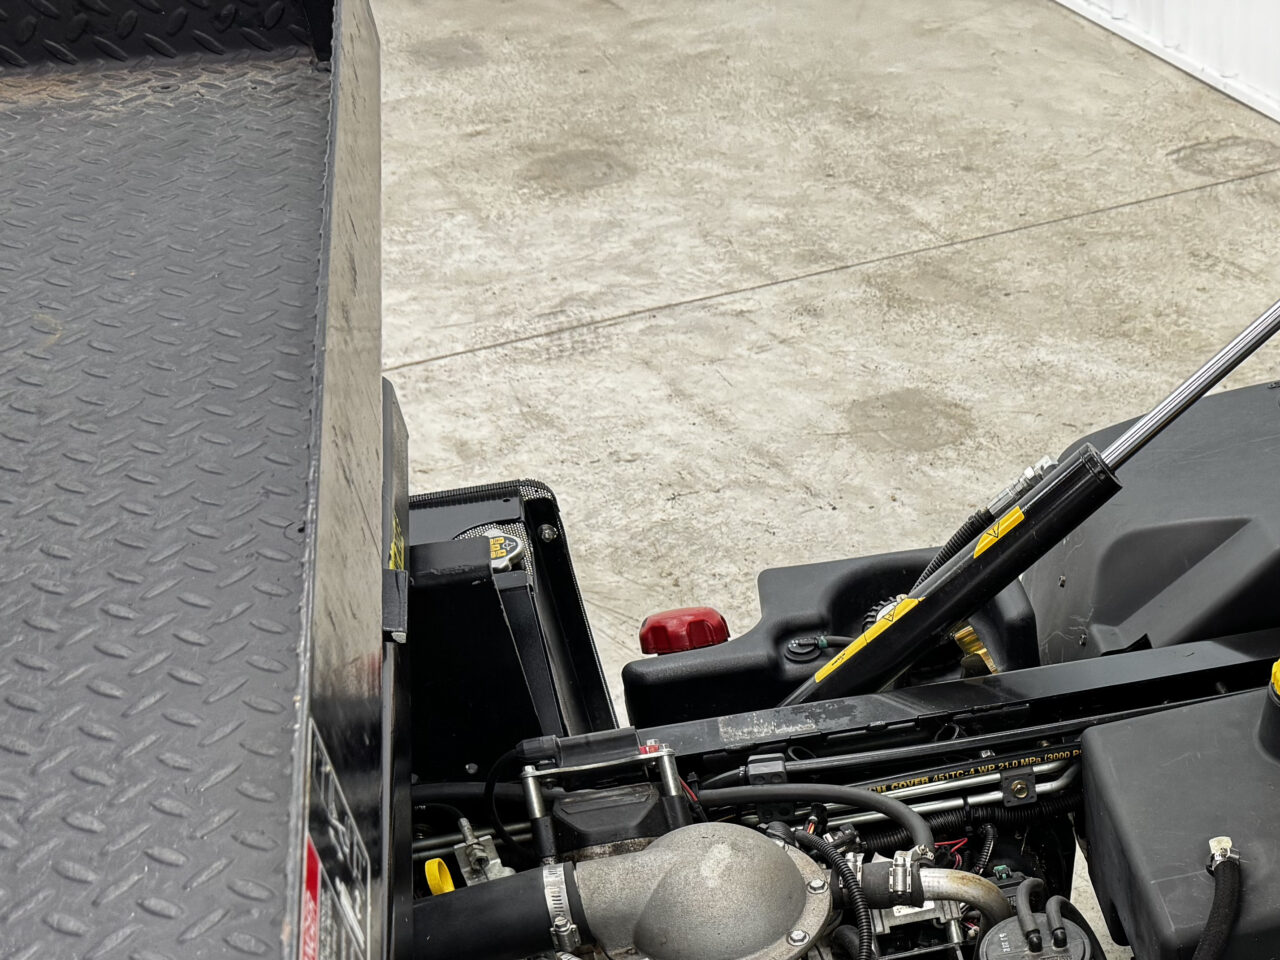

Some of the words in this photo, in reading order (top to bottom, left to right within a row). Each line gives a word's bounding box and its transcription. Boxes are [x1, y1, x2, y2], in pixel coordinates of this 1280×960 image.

[932, 768, 975, 782] 451TC-4
[978, 764, 995, 773] WP
[998, 759, 1018, 769] 21.0
[1019, 755, 1041, 765] MPa
